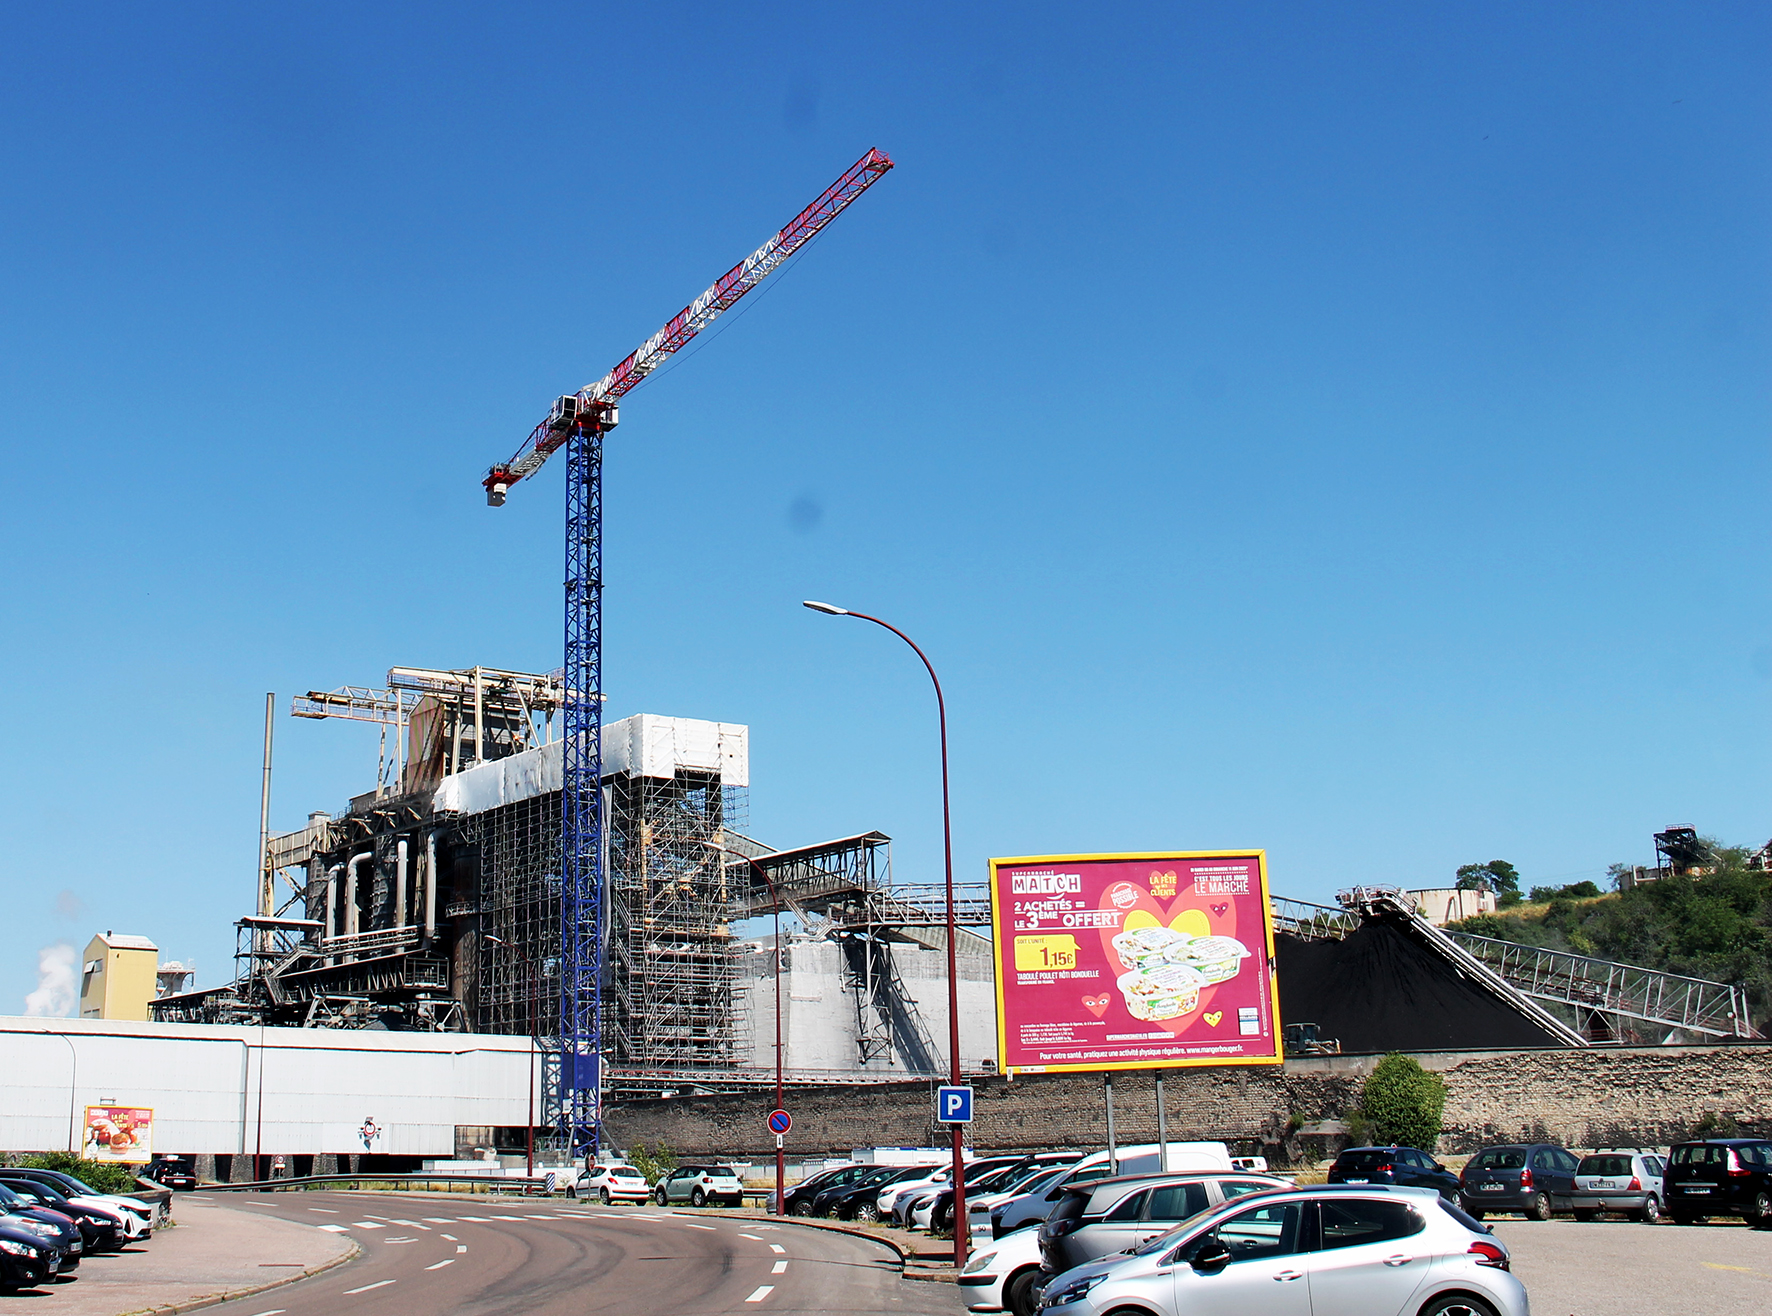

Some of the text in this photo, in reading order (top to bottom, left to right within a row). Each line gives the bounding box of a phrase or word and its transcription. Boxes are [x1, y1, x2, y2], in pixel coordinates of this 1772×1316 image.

[1013, 875, 1079, 892] MATCH
[1149, 874, 1177, 884] LA FÊTE
[1150, 888, 1176, 896] CLIENTS
[1194, 881, 1249, 893] LE MARCHÉ
[1112, 890, 1139, 906] POSSIBLE
[1014, 902, 1021, 911] 2
[1024, 899, 1072, 911] ACHETÉS
[1014, 920, 1025, 928] LE
[1062, 913, 1123, 927] OFFERT
[1039, 947, 1073, 968] 1,15€
[1017, 971, 1039, 980] TABOULÉ
[1039, 972, 1058, 980] POULET
[1071, 970, 1099, 979] BONDUELLE
[1040, 1052, 1052, 1060] Pour
[1084, 1051, 1107, 1059] pratiquez
[1139, 1048, 1161, 1057] physique
[948, 1094, 962, 1115] P
